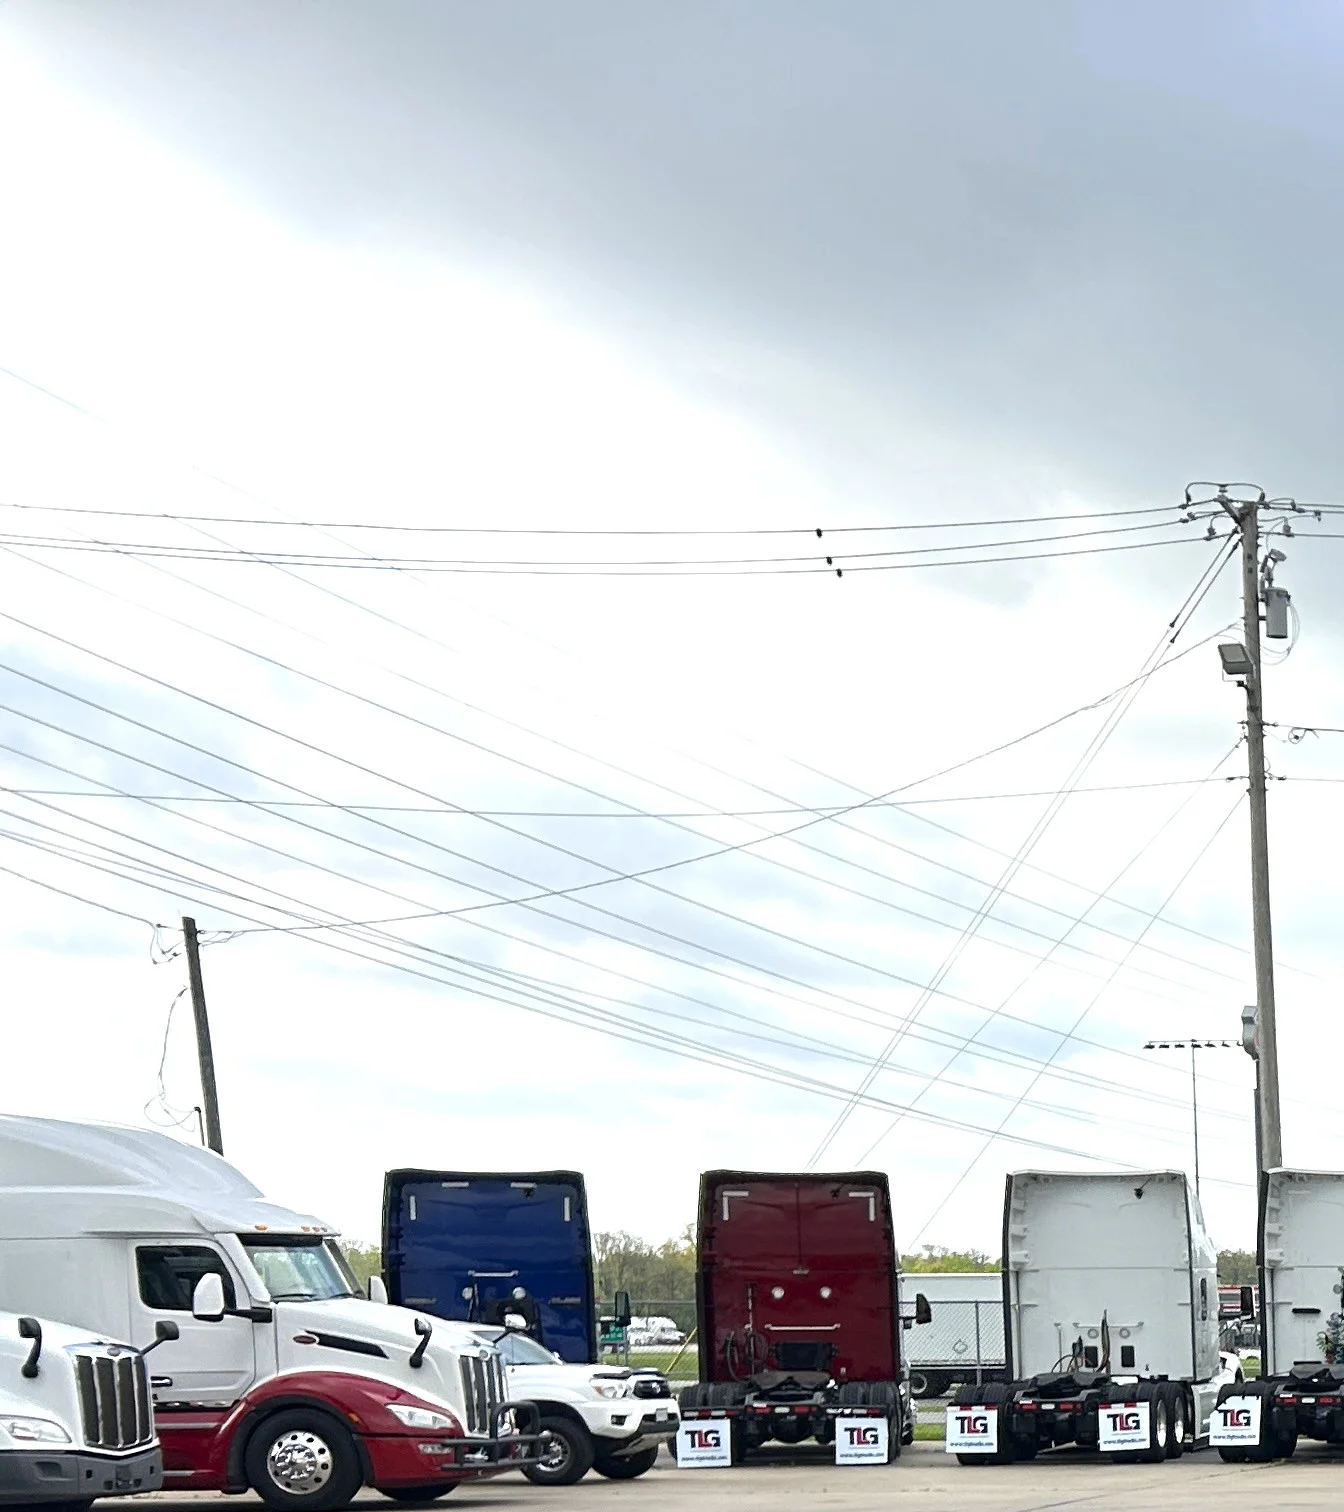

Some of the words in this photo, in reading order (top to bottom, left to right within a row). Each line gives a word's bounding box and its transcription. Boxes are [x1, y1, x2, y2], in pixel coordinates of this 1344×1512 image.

[955, 1416, 988, 1434] TLG
[1107, 1412, 1140, 1431] TLG
[1217, 1408, 1251, 1427] TLG
[685, 1430, 721, 1448] TLG
[844, 1427, 879, 1446] TLG
